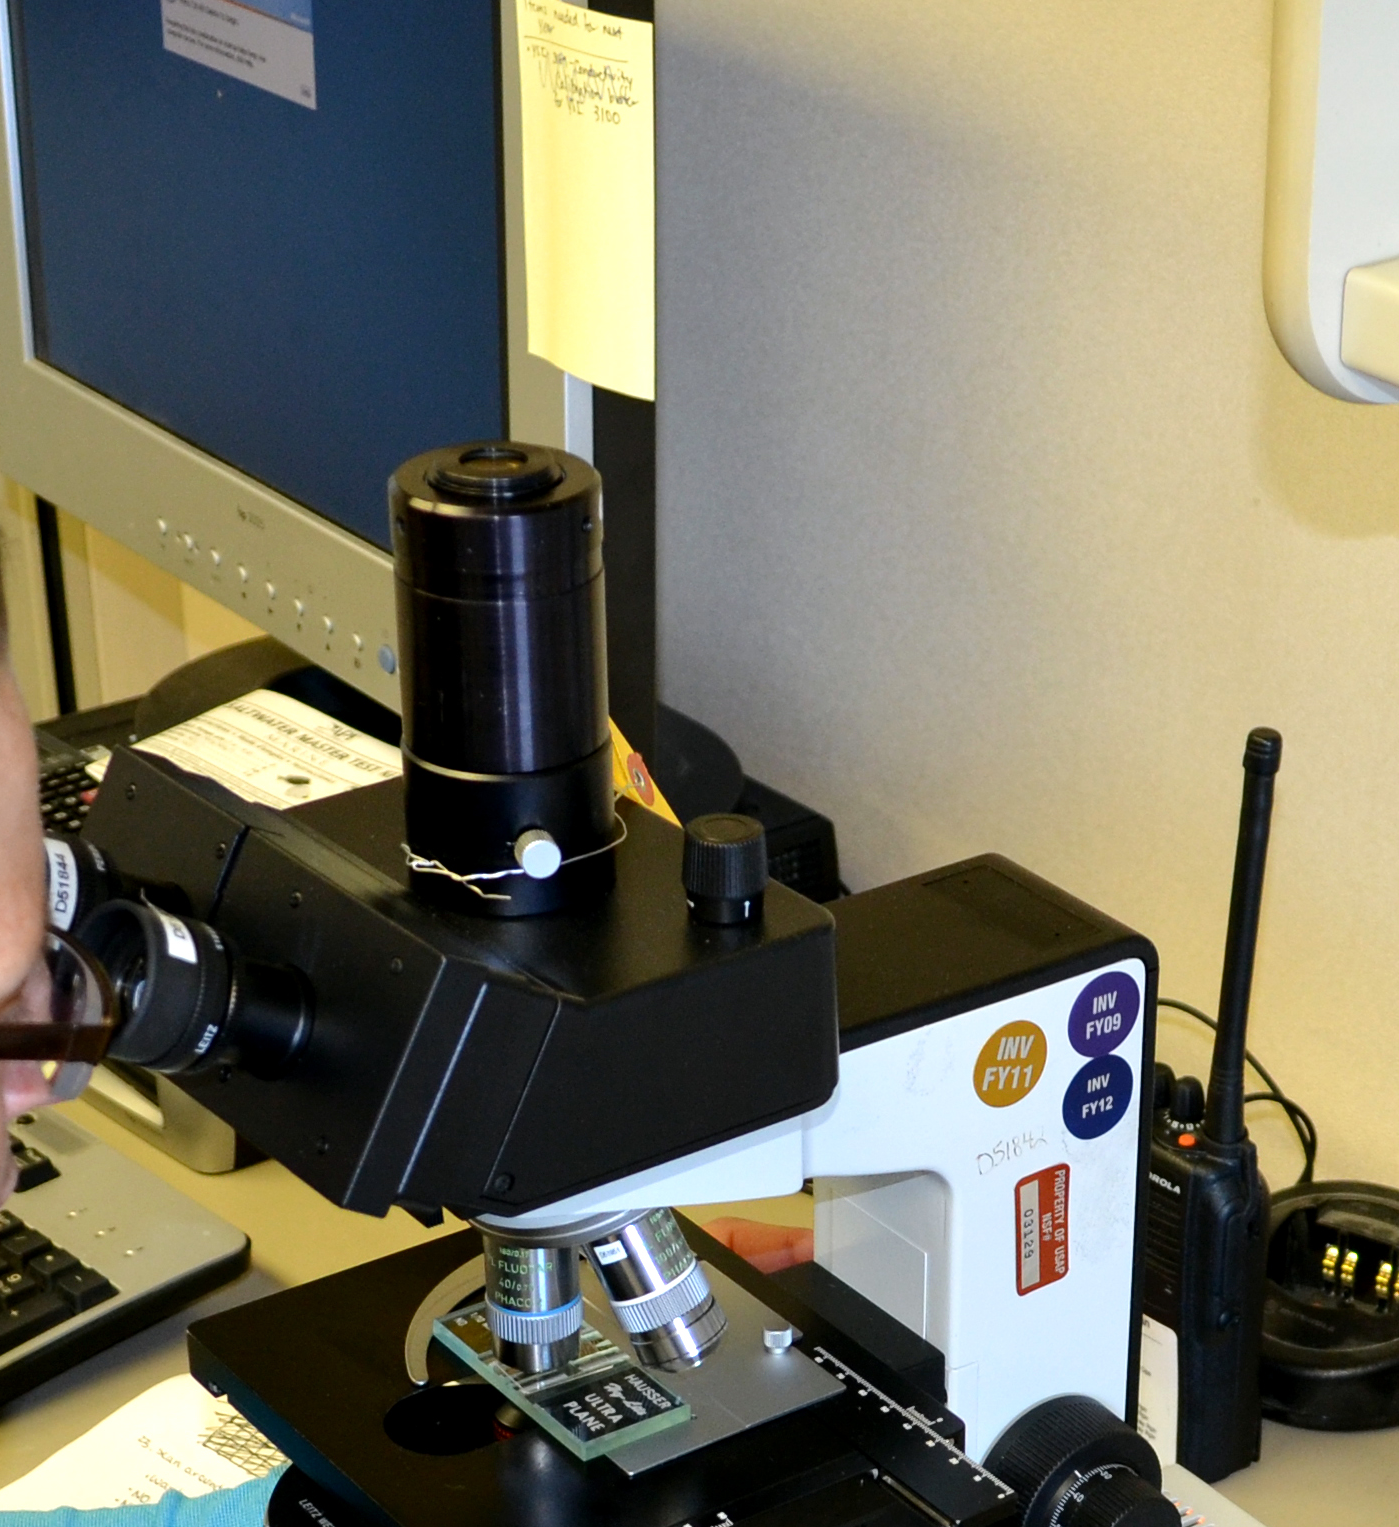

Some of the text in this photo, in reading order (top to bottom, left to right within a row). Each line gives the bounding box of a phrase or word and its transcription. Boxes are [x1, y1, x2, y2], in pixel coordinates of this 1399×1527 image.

[298, 732, 350, 762] MASTER
[352, 756, 380, 774] TEST
[1093, 990, 1118, 1015] INV
[194, 1023, 219, 1055] LEITZ
[1085, 1012, 1122, 1041] FY09
[996, 1034, 1035, 1061] INV
[982, 1064, 1034, 1092] FY11
[1087, 1073, 1111, 1094] INV
[1081, 1095, 1114, 1119] FY12
[1023, 1208, 1034, 1260] 03129
[1054, 1168, 1066, 1275] PROPERTY OF USAP
[624, 1373, 672, 1410] HAUSSER
[563, 1401, 606, 1433] PLANE
[584, 1393, 624, 1424] ULTRA
[299, 1498, 323, 1519] LEITZ
